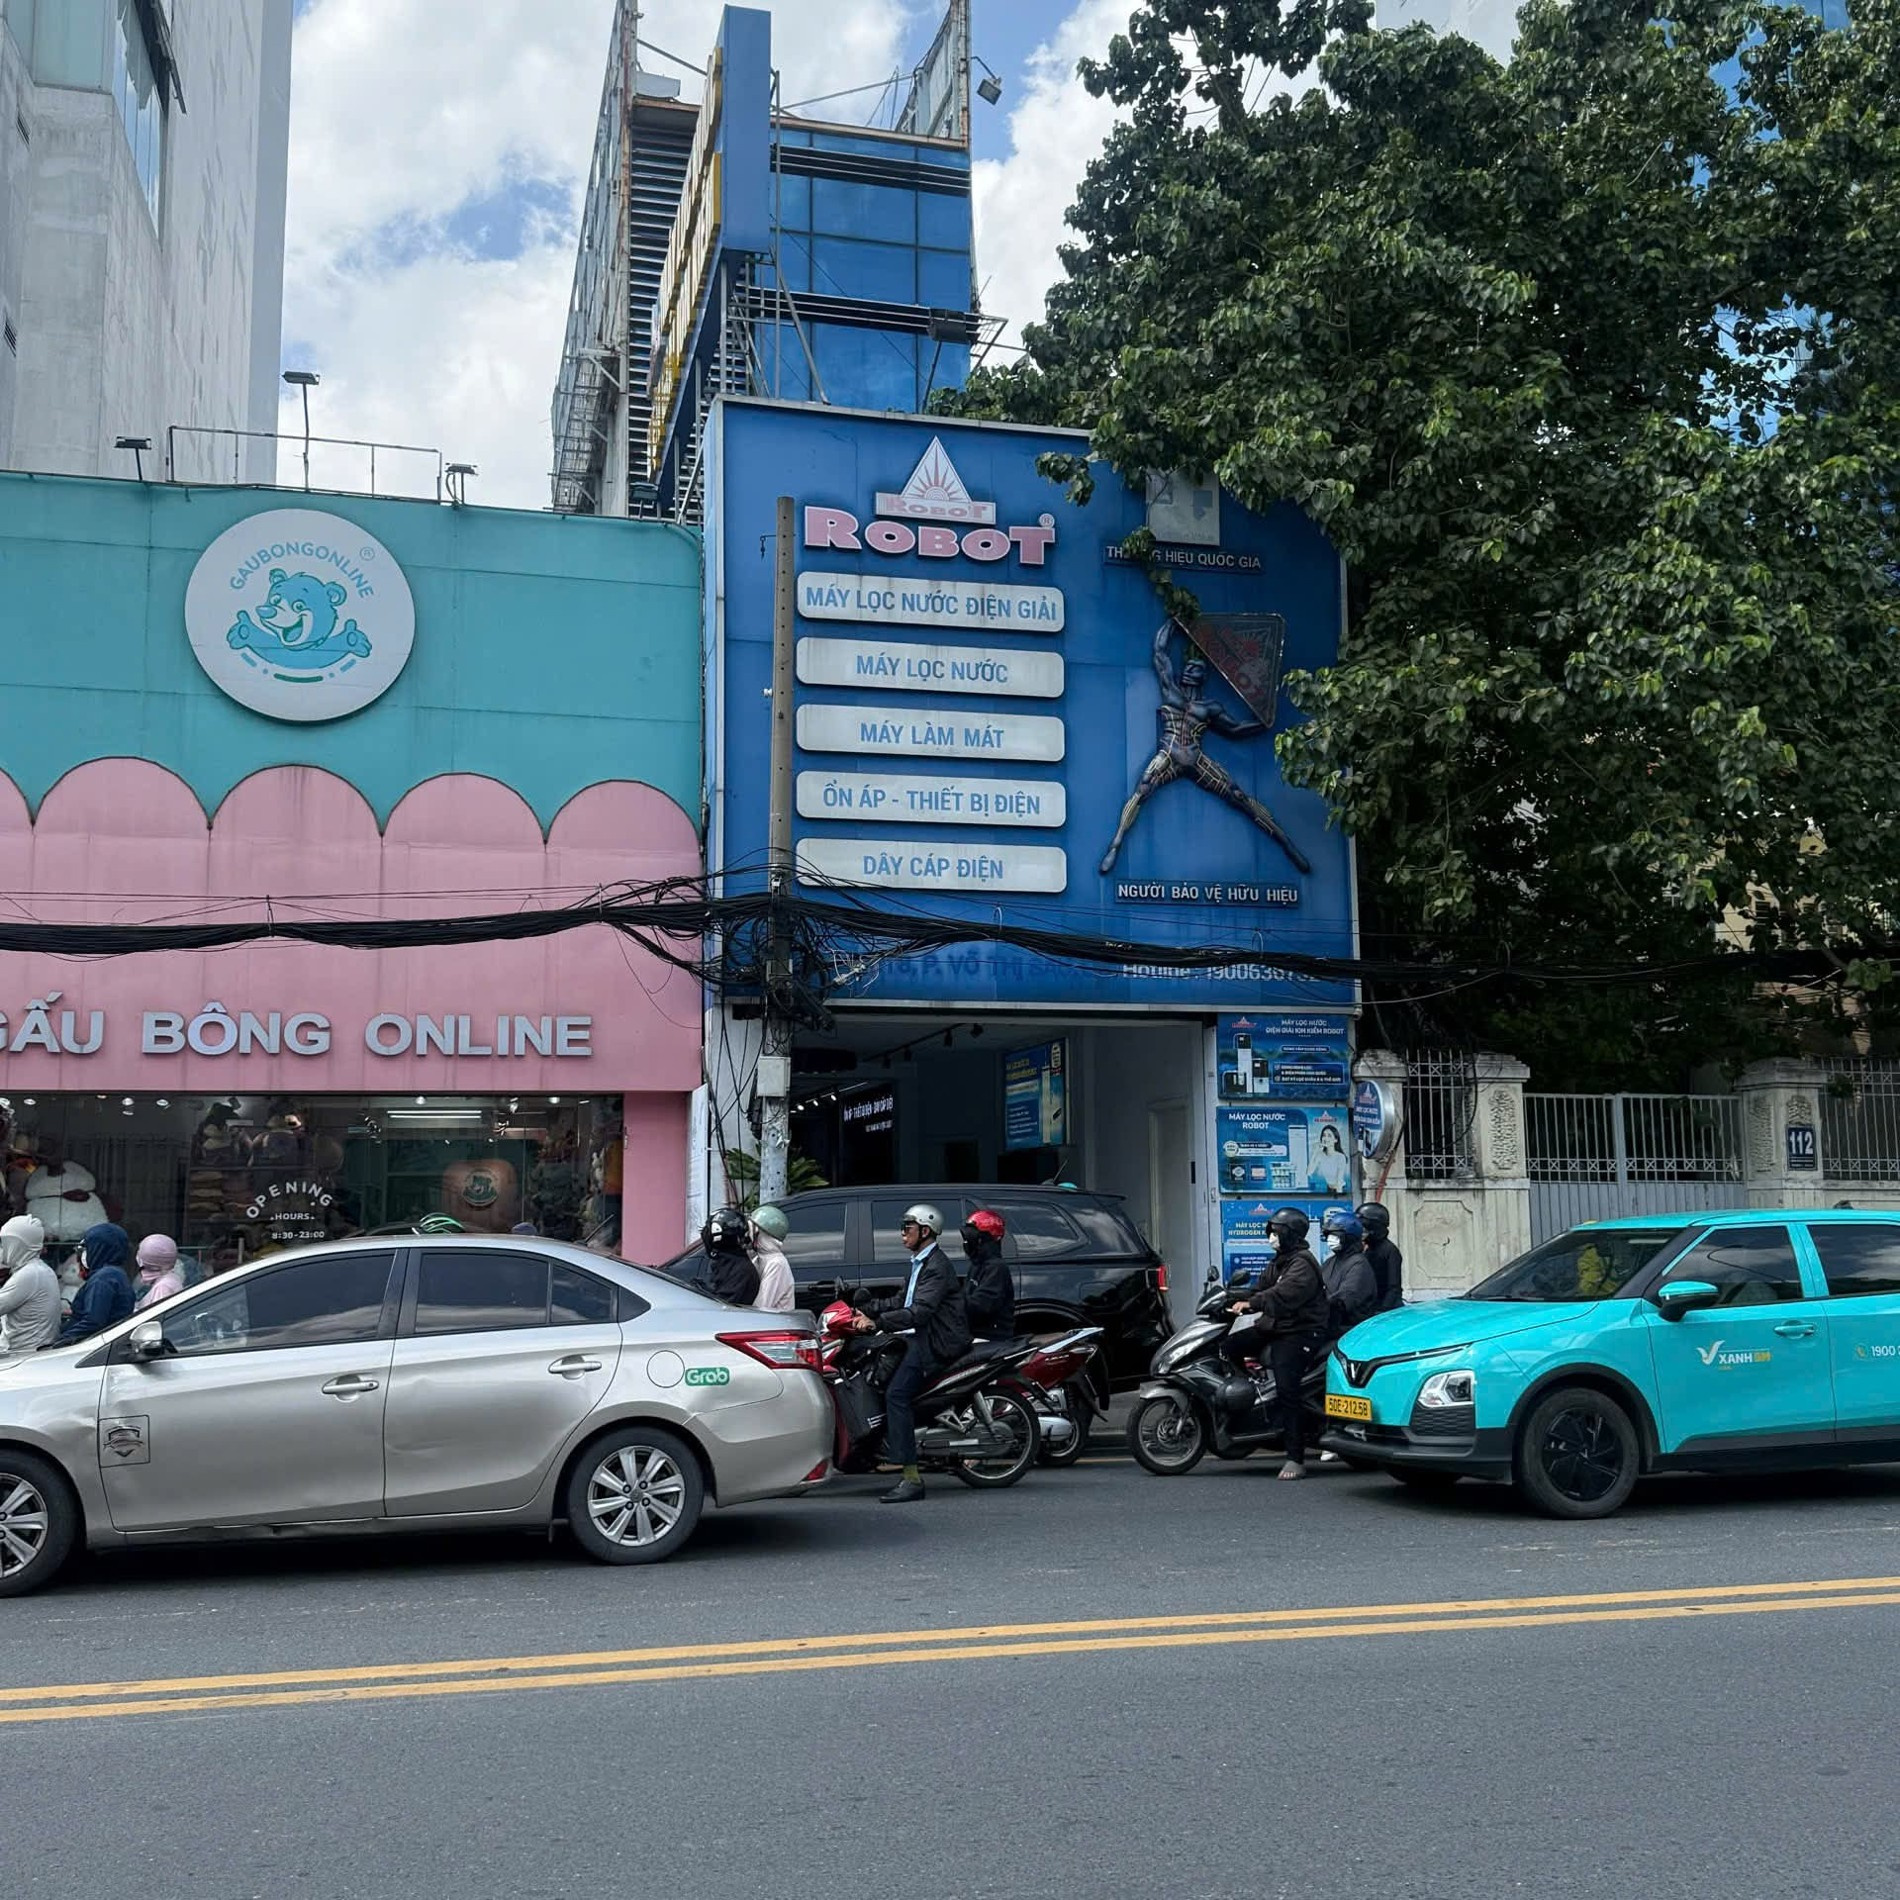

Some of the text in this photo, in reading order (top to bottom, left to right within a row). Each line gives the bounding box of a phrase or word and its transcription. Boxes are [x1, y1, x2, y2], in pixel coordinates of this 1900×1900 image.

[885, 498, 988, 519] ROBOT
[804, 505, 1056, 565] ROBOT
[229, 541, 375, 599] GAUBONGONLINE
[1238, 555, 1261, 569] GIA
[806, 586, 1058, 622] MÁY LỌC NƯỚC ĐIỆN GIẢI
[856, 652, 1009, 682] MÁY LỌC NƯỚC
[860, 720, 1005, 748] MÁY LÀM MÁT
[823, 779, 853, 808] ỔN
[859, 784, 887, 808] ÁP
[906, 784, 963, 812] THIẾT
[970, 793, 989, 817] BỊ
[994, 791, 1041, 818] ĐIỆN
[863, 853, 1004, 880] DÂY CÁP ĐIỆN
[1118, 882, 1298, 906] NGƯỜI BẢO VỆ HỮU HIỆU
[0, 992, 592, 1057] ẤU BÔNG ONLINE
[1228, 1111, 1286, 1122] MÁY LỌC NƯỚC
[1242, 1121, 1269, 1130] ROBOT
[1790, 1131, 1814, 1155] 112
[246, 1181, 332, 1218] OPENING
[1719, 1352, 1752, 1364] XANH
[1870, 1345, 1895, 1356] 1900
[686, 1368, 728, 1384] Grab
